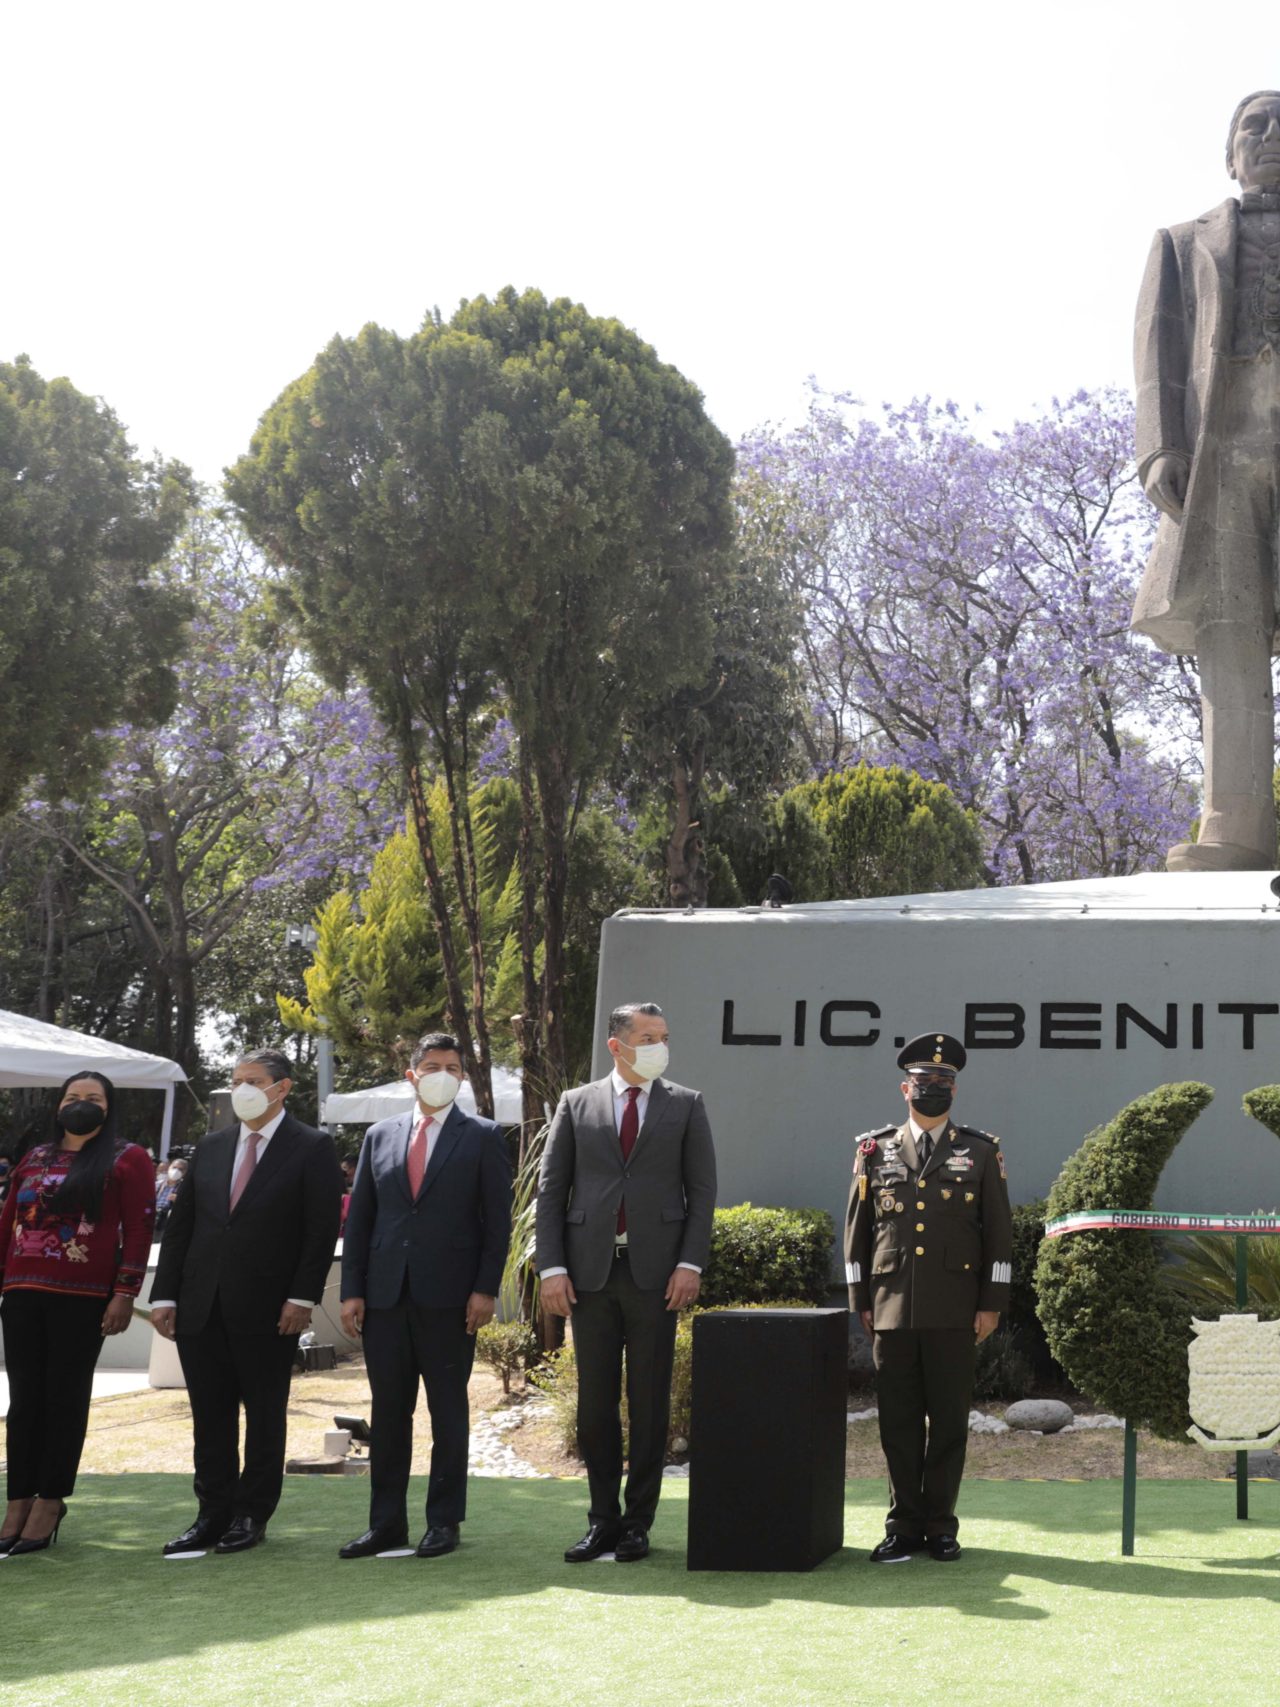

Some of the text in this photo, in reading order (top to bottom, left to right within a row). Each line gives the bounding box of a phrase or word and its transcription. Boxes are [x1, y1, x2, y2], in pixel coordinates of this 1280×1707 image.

[722, 999, 905, 1048] LIC.
[1111, 1211, 1181, 1229] GOBIERNO
[1188, 1216, 1214, 1230] DEL
[1223, 1217, 1277, 1231] ESTADO
